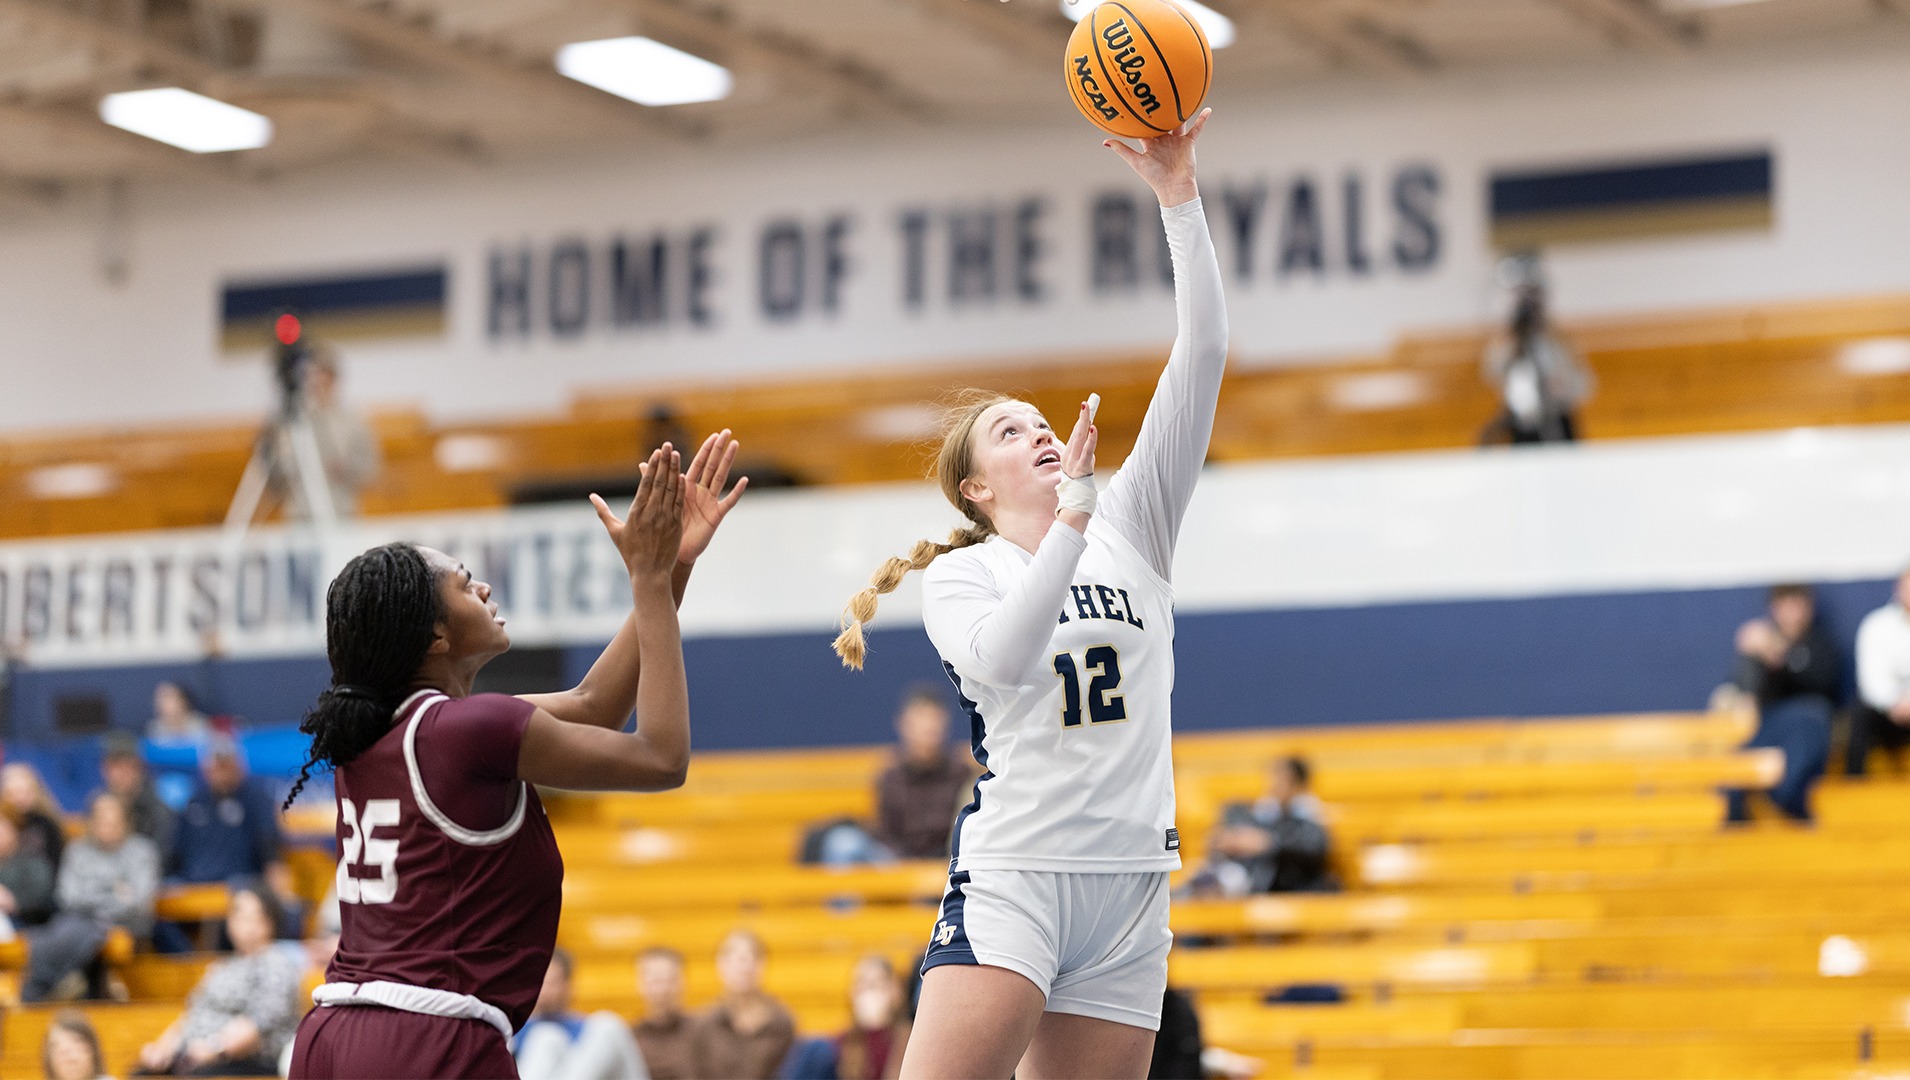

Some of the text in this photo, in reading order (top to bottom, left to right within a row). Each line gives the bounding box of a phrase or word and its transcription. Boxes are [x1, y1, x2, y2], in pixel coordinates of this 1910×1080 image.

[1074, 55, 1120, 121] NCAA
[1102, 18, 1161, 115] Wilson
[487, 166, 1442, 342] HOME OF THE RYALS
[0, 548, 320, 640] BERTSON
[1058, 583, 1145, 632] HEL
[1051, 642, 1130, 730] 12
[336, 798, 401, 905] 25
